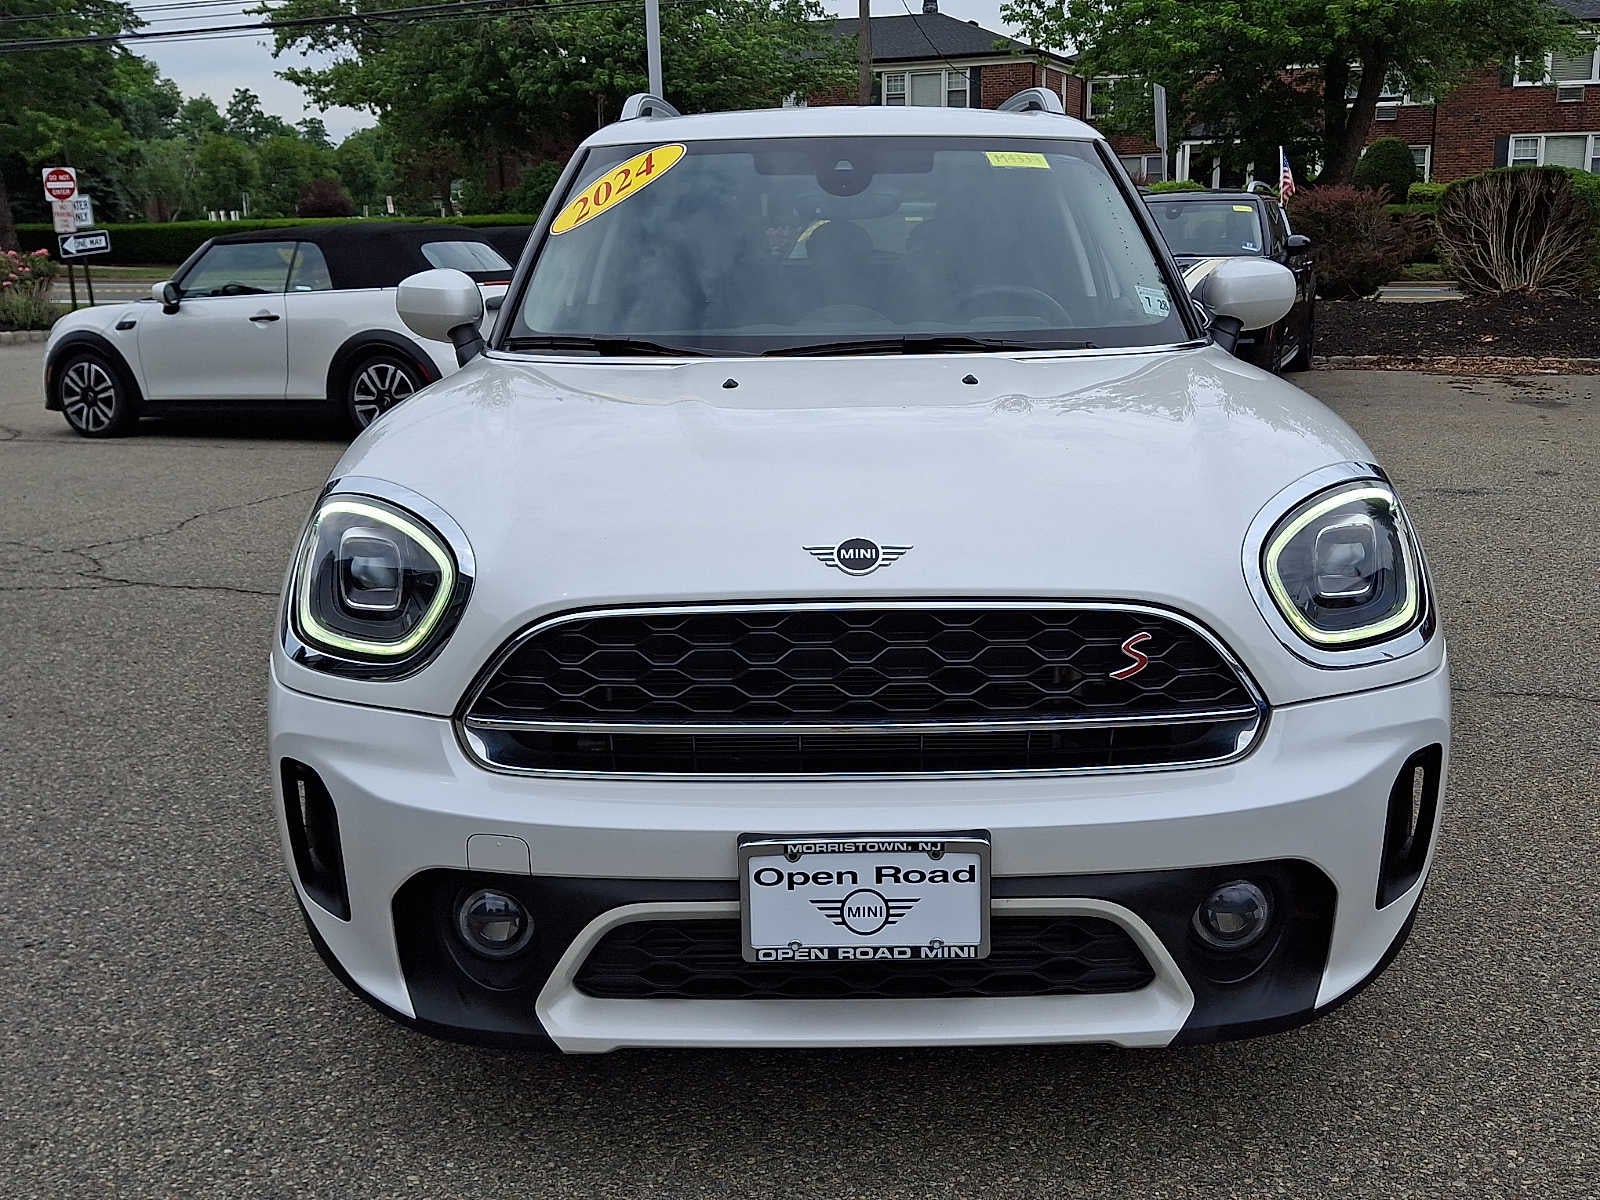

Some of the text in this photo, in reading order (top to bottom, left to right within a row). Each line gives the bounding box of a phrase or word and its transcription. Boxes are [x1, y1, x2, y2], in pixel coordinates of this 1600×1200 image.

[52, 188, 71, 196] ENTER
[574, 152, 655, 224] 2024
[73, 239, 87, 249] ONE
[1145, 296, 1169, 312] 7 28
[840, 548, 876, 559] MINI
[1109, 631, 1152, 681] S
[787, 842, 942, 853] MORRISTOWN, NJ
[753, 864, 977, 891] Open Road
[847, 906, 884, 918] MINI
[757, 946, 976, 961] OPEN ROAD MINI
